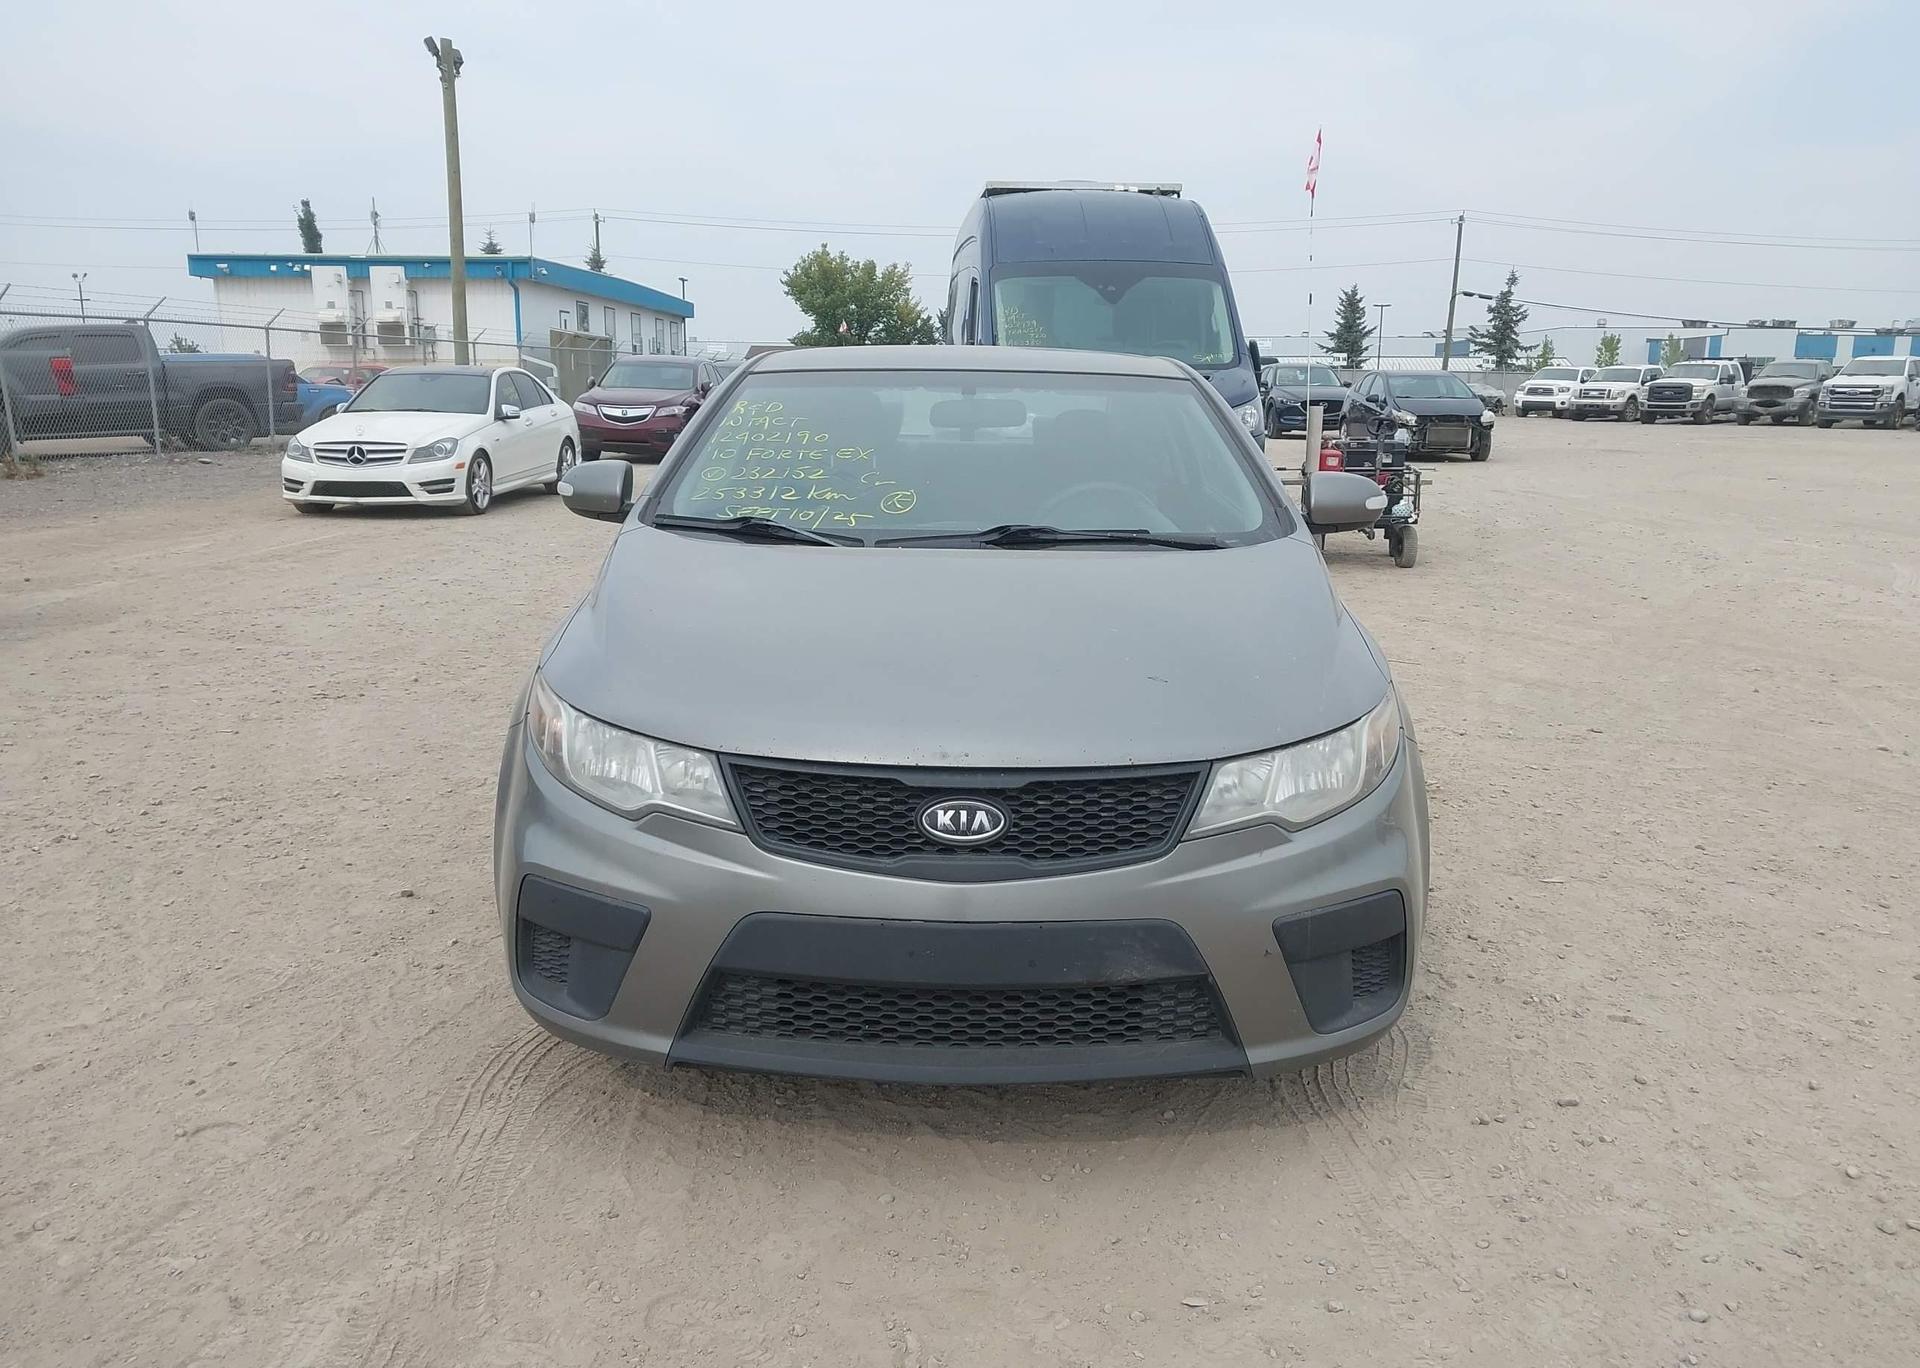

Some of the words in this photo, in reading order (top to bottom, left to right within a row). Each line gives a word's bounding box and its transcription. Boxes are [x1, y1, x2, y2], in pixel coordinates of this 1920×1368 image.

[746, 447, 828, 461] FORTE
[836, 448, 875, 461] EX
[730, 465, 830, 480] 232152
[690, 486, 801, 501] 253312
[936, 809, 992, 832] KIA
